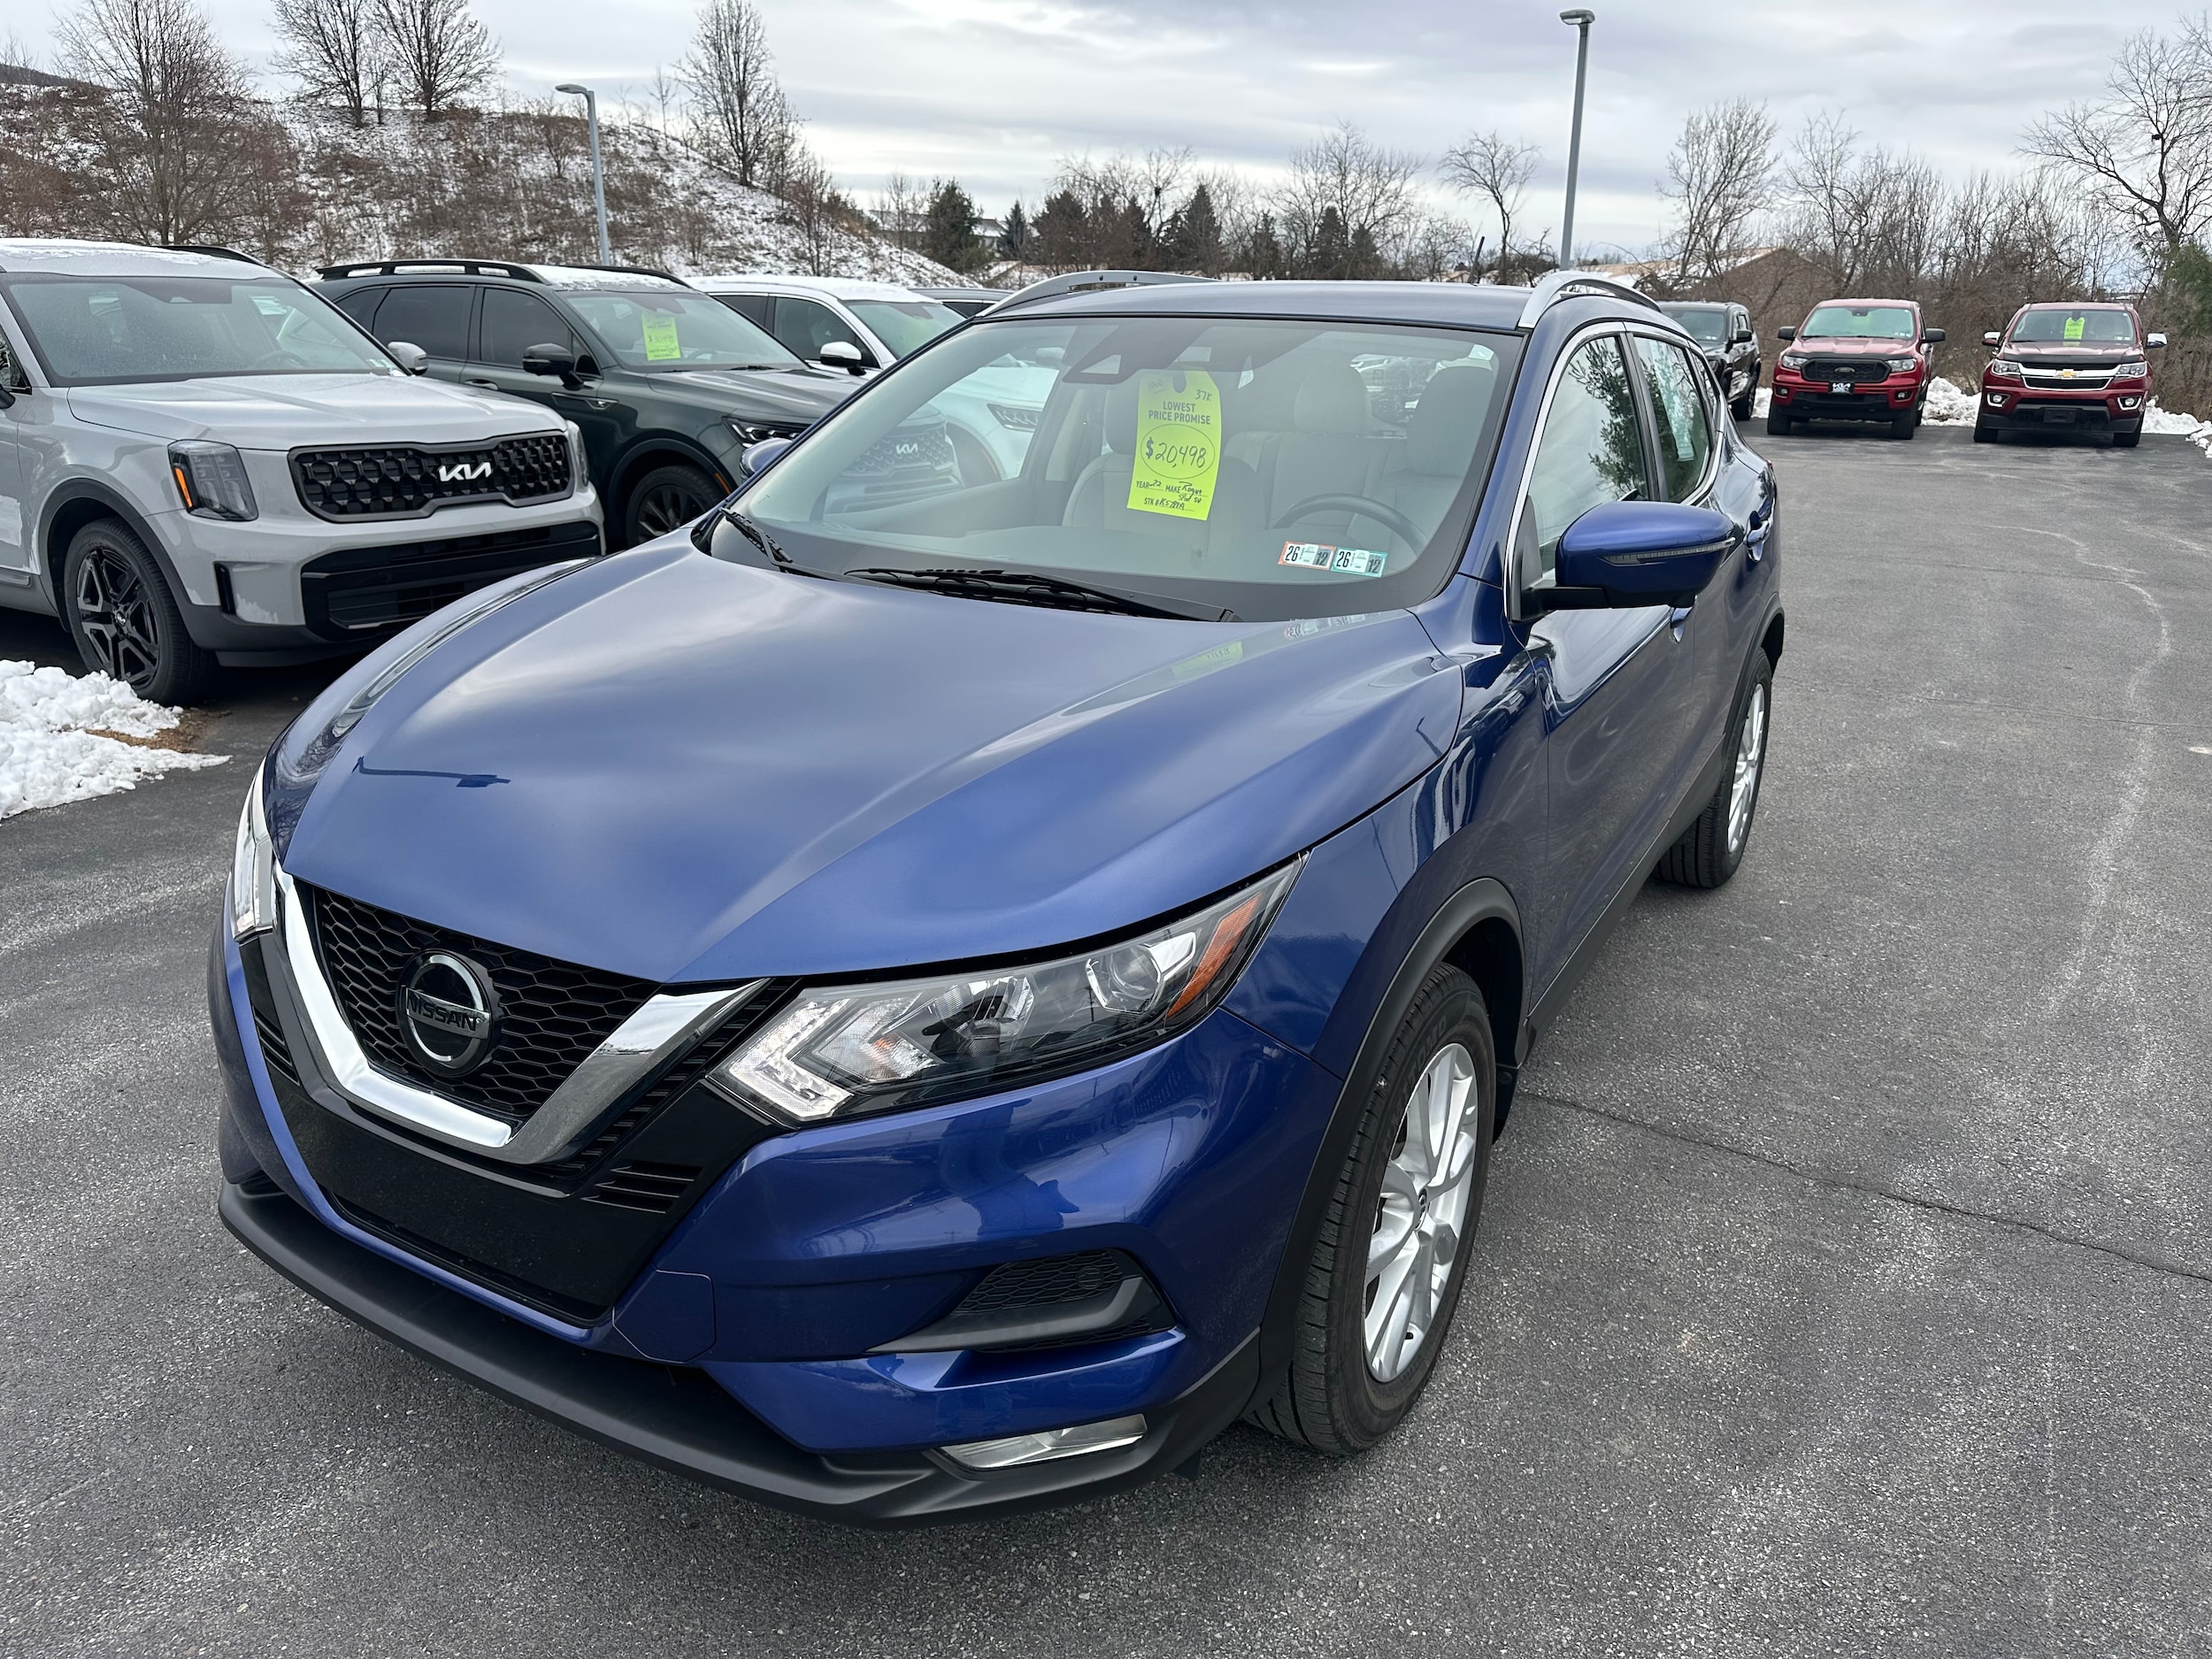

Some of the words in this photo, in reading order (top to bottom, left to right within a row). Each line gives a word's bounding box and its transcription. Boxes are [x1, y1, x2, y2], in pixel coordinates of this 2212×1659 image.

[1163, 401, 1196, 413] LOWEST
[1148, 410, 1172, 421] PRICE
[1174, 412, 1211, 426] PROMISE
[895, 442, 918, 455] KIA
[438, 461, 492, 482] KIA
[1136, 480, 1149, 489] YEAR
[1165, 484, 1181, 494] MAKE
[1285, 545, 1301, 562] 26
[1316, 551, 1329, 566] 12
[1336, 550, 1351, 568] 26
[1368, 558, 1380, 573] 12
[407, 989, 479, 1032] NISSAN
